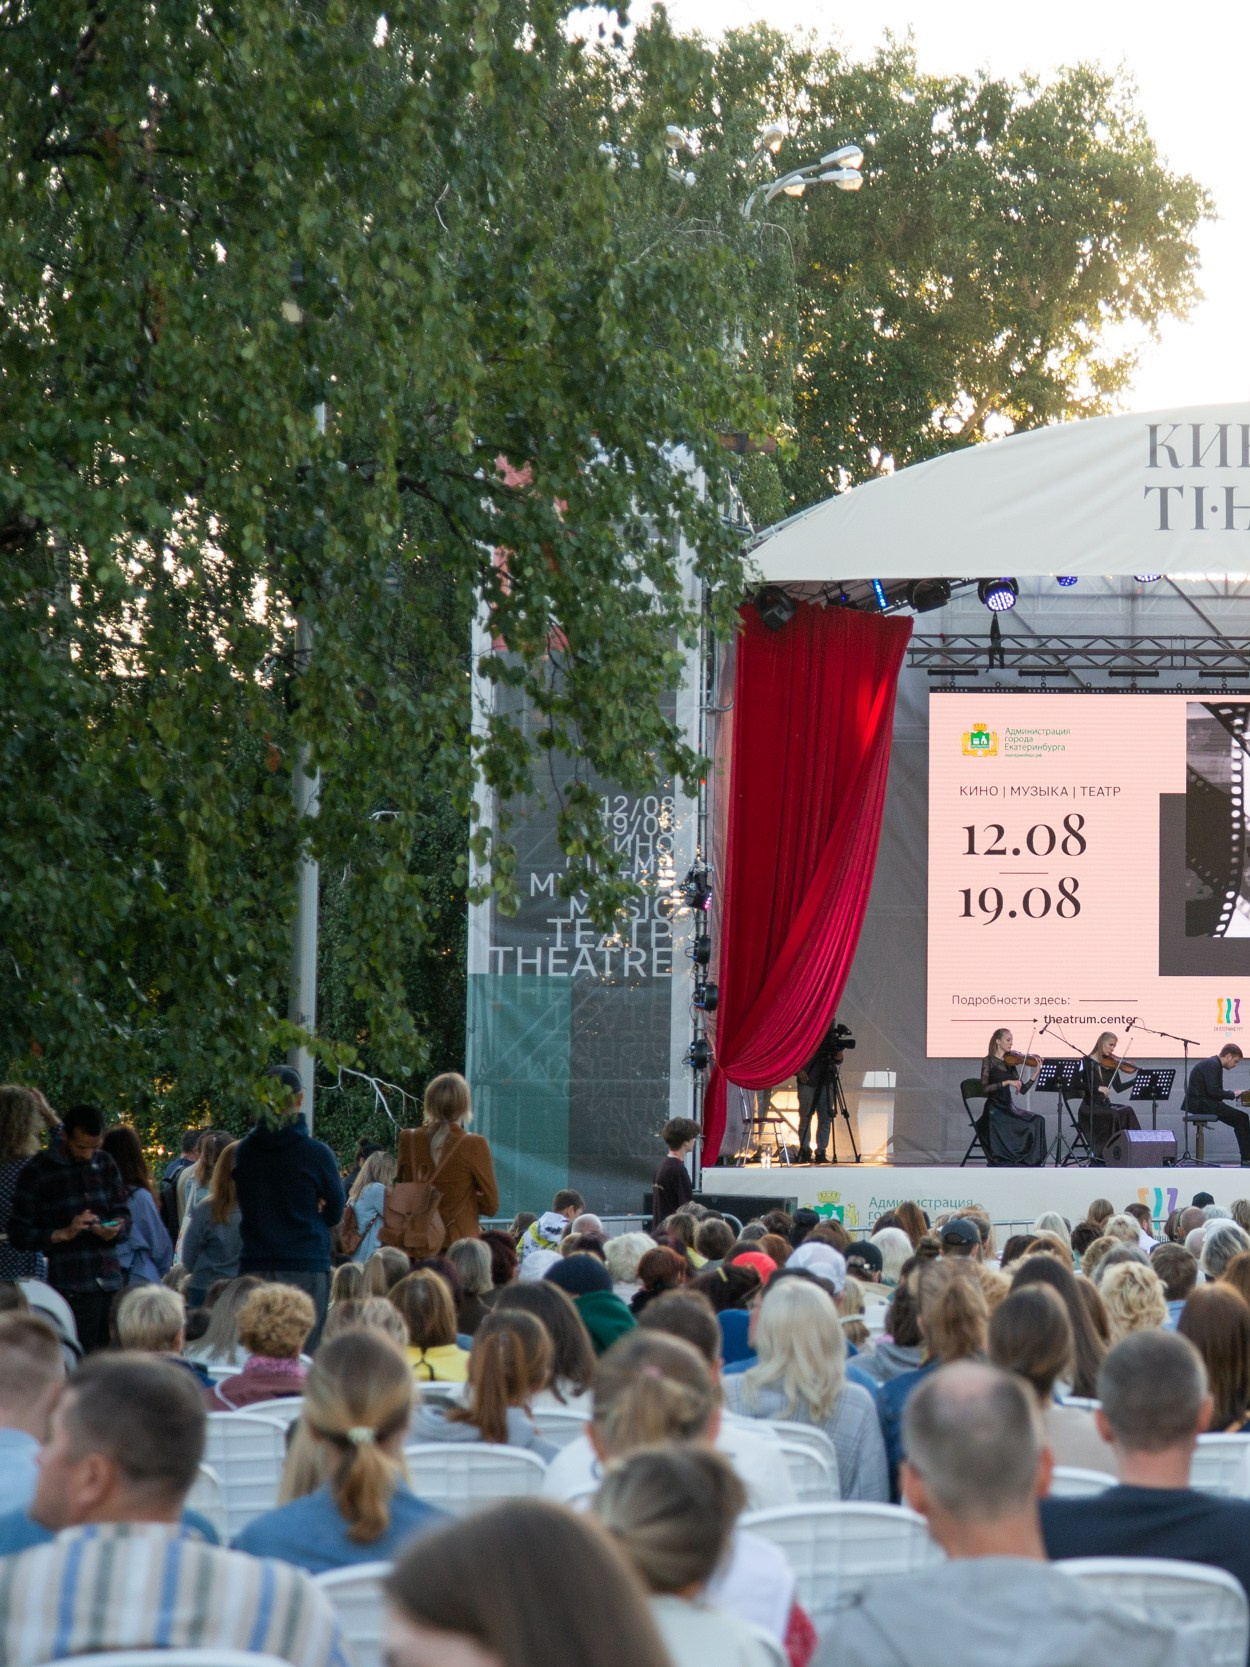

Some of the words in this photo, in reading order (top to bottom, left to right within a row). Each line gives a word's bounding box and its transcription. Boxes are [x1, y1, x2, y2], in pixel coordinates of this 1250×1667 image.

[1005, 727, 1071, 736] Администрация
[1005, 736, 1034, 744] города
[1005, 743, 1066, 752] Екатеринбурга
[960, 786, 999, 796] КИНО
[1010, 786, 1069, 797] МУЗЫКА
[1080, 786, 1121, 797] ТЕАТР
[600, 795, 675, 821] 12/08
[962, 813, 1087, 856] 12.08
[613, 834, 675, 857] ИНО
[570, 896, 675, 921] MSIC
[958, 876, 1081, 926] 19.08
[488, 946, 672, 977] THEATRE
[952, 994, 1031, 1006] Подробности
[1034, 997, 1071, 1006] здесь:
[1044, 1014, 1138, 1025] theatrum.center
